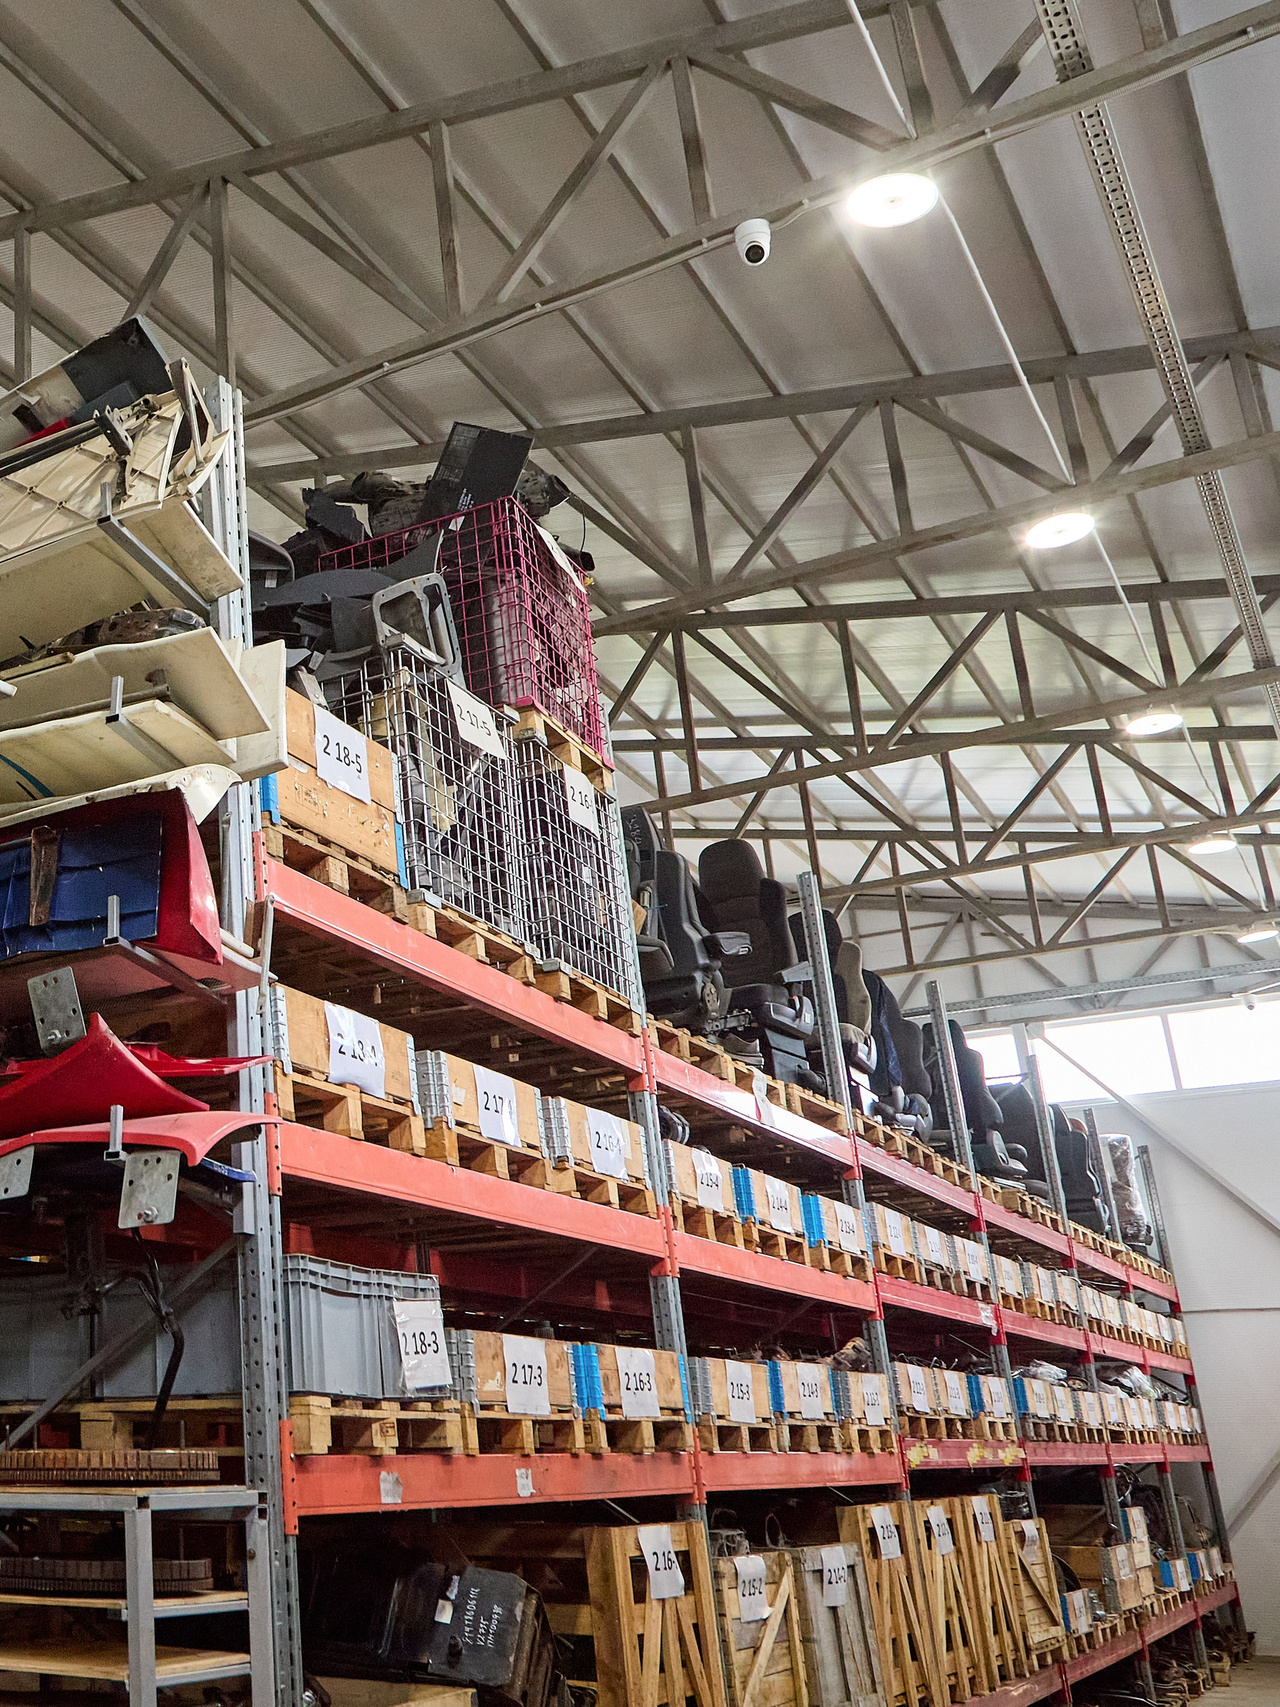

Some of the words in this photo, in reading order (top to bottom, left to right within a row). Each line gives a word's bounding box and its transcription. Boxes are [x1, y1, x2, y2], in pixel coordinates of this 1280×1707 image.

[457, 703, 466, 721] 2
[466, 710, 491, 736] 17-5
[323, 734, 331, 756] 2
[335, 742, 362, 774] 18-5
[570, 786, 577, 802] 2
[578, 791, 593, 810] 16-
[483, 1091, 491, 1111] 2
[595, 1131, 601, 1149] 2
[771, 1194, 776, 1209] 2
[840, 1219, 844, 1232] 2
[402, 1332, 410, 1356] 2
[412, 1330, 439, 1356] 18-3
[511, 1363, 518, 1384] 2
[522, 1364, 543, 1387] 17-3
[625, 1372, 631, 1391] 2
[634, 1372, 652, 1392] 16-3
[731, 1382, 735, 1399] 2
[736, 1383, 750, 1400] 15-3
[802, 1382, 806, 1398] 2
[808, 1383, 818, 1399] 14-3
[881, 1525, 886, 1540] 2
[653, 1551, 661, 1571] 2
[663, 1550, 678, 1571] 16-
[828, 1568, 833, 1584] 2
[741, 1580, 746, 1597] 2
[748, 1578, 763, 1597] 15-2
